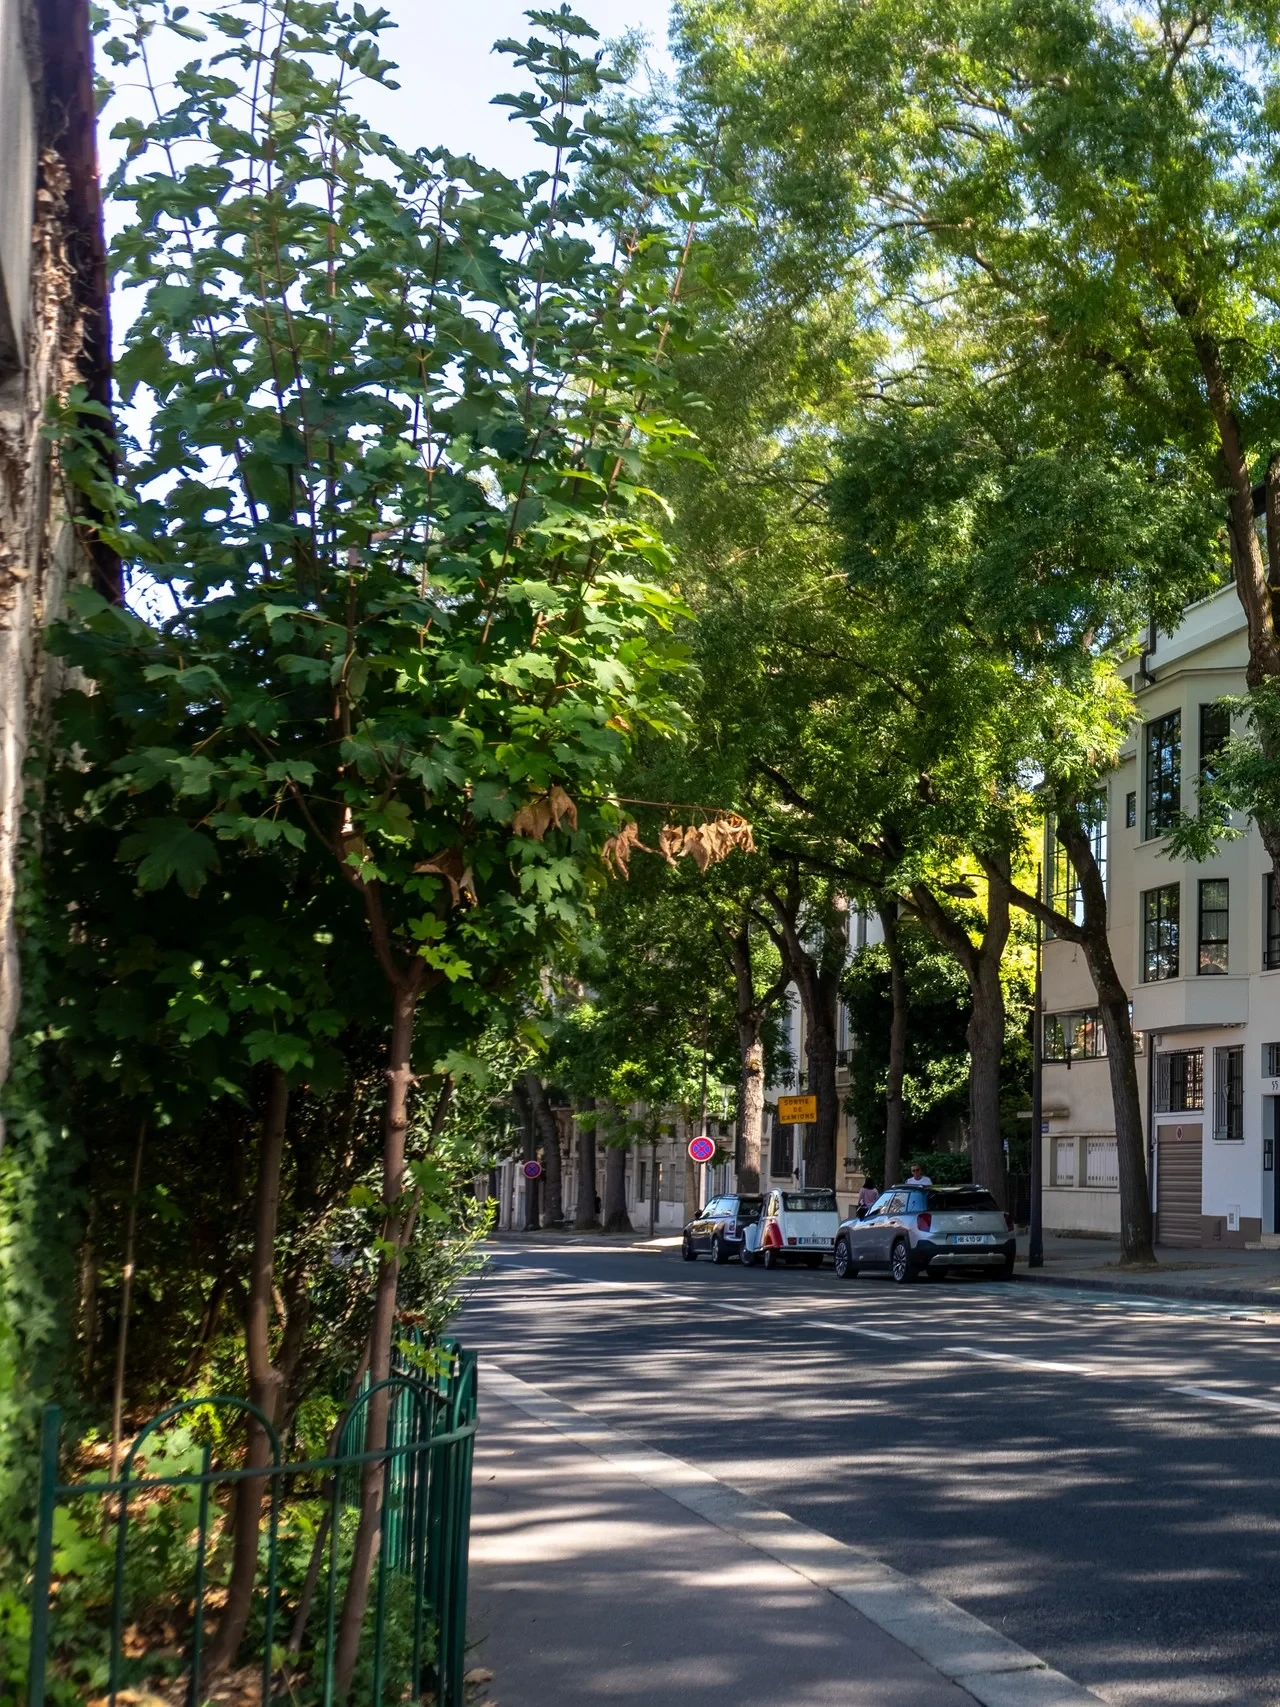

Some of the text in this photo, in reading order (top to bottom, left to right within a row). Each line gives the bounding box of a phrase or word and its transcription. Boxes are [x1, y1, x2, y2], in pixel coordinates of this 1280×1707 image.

[1271, 1080, 1279, 1091] 55
[783, 1098, 809, 1106] SORTIE
[781, 1113, 815, 1121] CAMIONS
